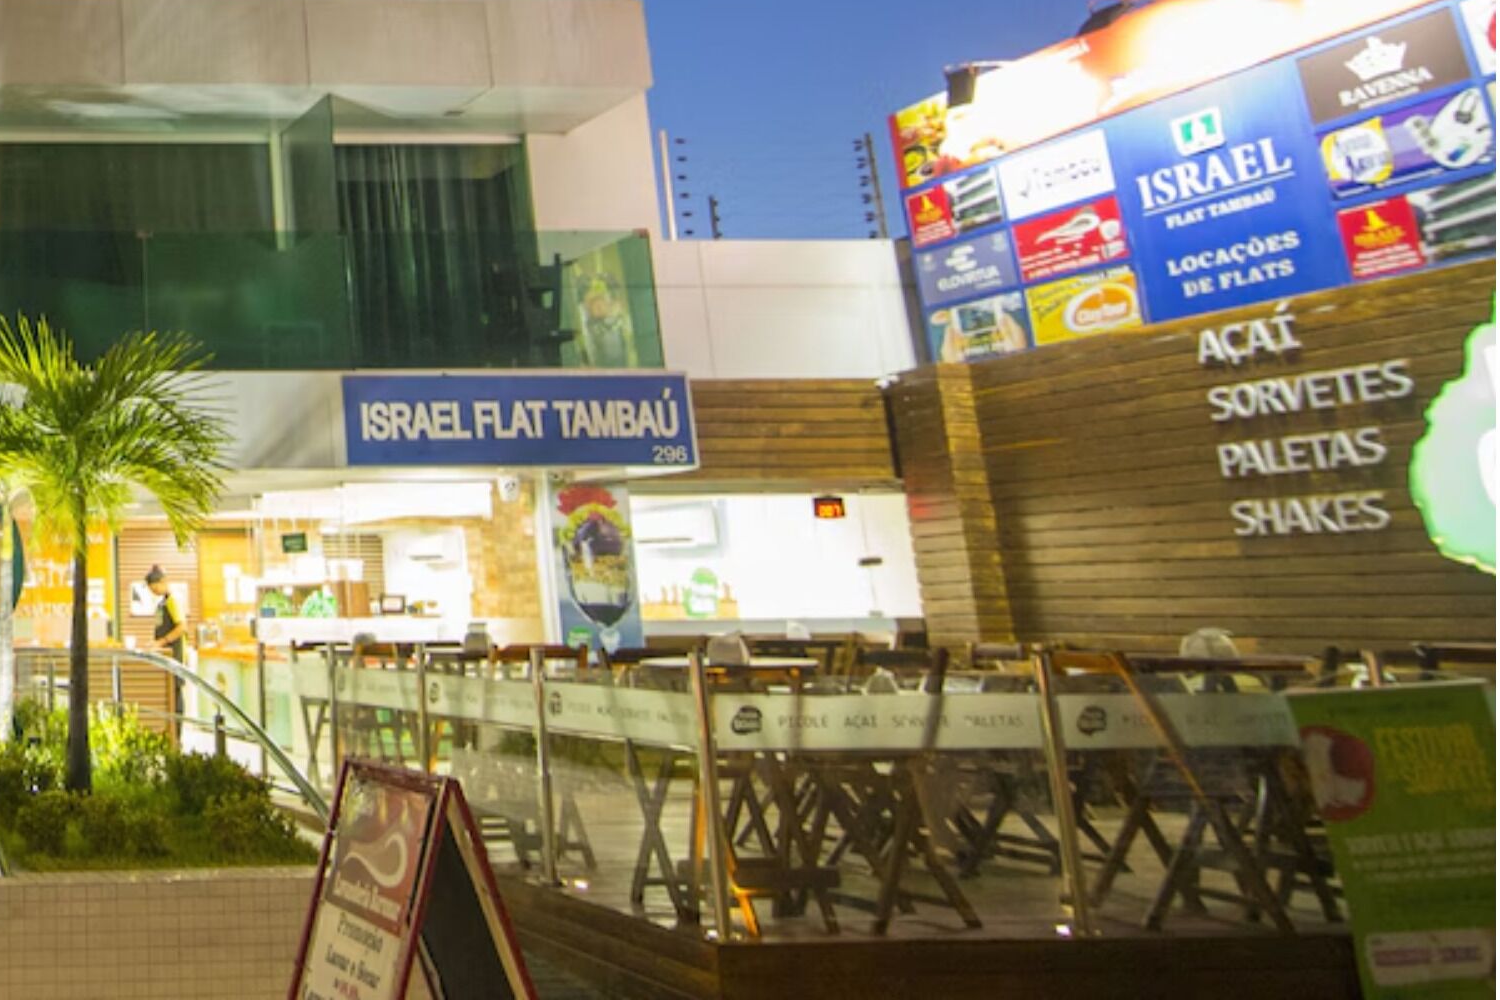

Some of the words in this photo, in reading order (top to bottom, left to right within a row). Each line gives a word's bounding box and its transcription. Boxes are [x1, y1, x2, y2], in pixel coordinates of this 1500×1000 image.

[1338, 66, 1434, 107] RAVENNA
[1135, 138, 1293, 210] ISRAEL
[1165, 208, 1206, 229] FLAT
[1166, 230, 1300, 277] LOCAÇÕES
[1182, 276, 1215, 299] DE
[1218, 259, 1296, 290] FLATS
[1198, 302, 1302, 365] AÇAÍ
[359, 402, 473, 441] ISRAEL
[473, 400, 547, 440] FLAT
[551, 387, 679, 439] TAMBAÚ
[1206, 359, 1415, 422] SORVETES
[651, 445, 688, 463] 296
[1217, 427, 1388, 477] PALETAS
[1229, 492, 1391, 536] SHAKES
